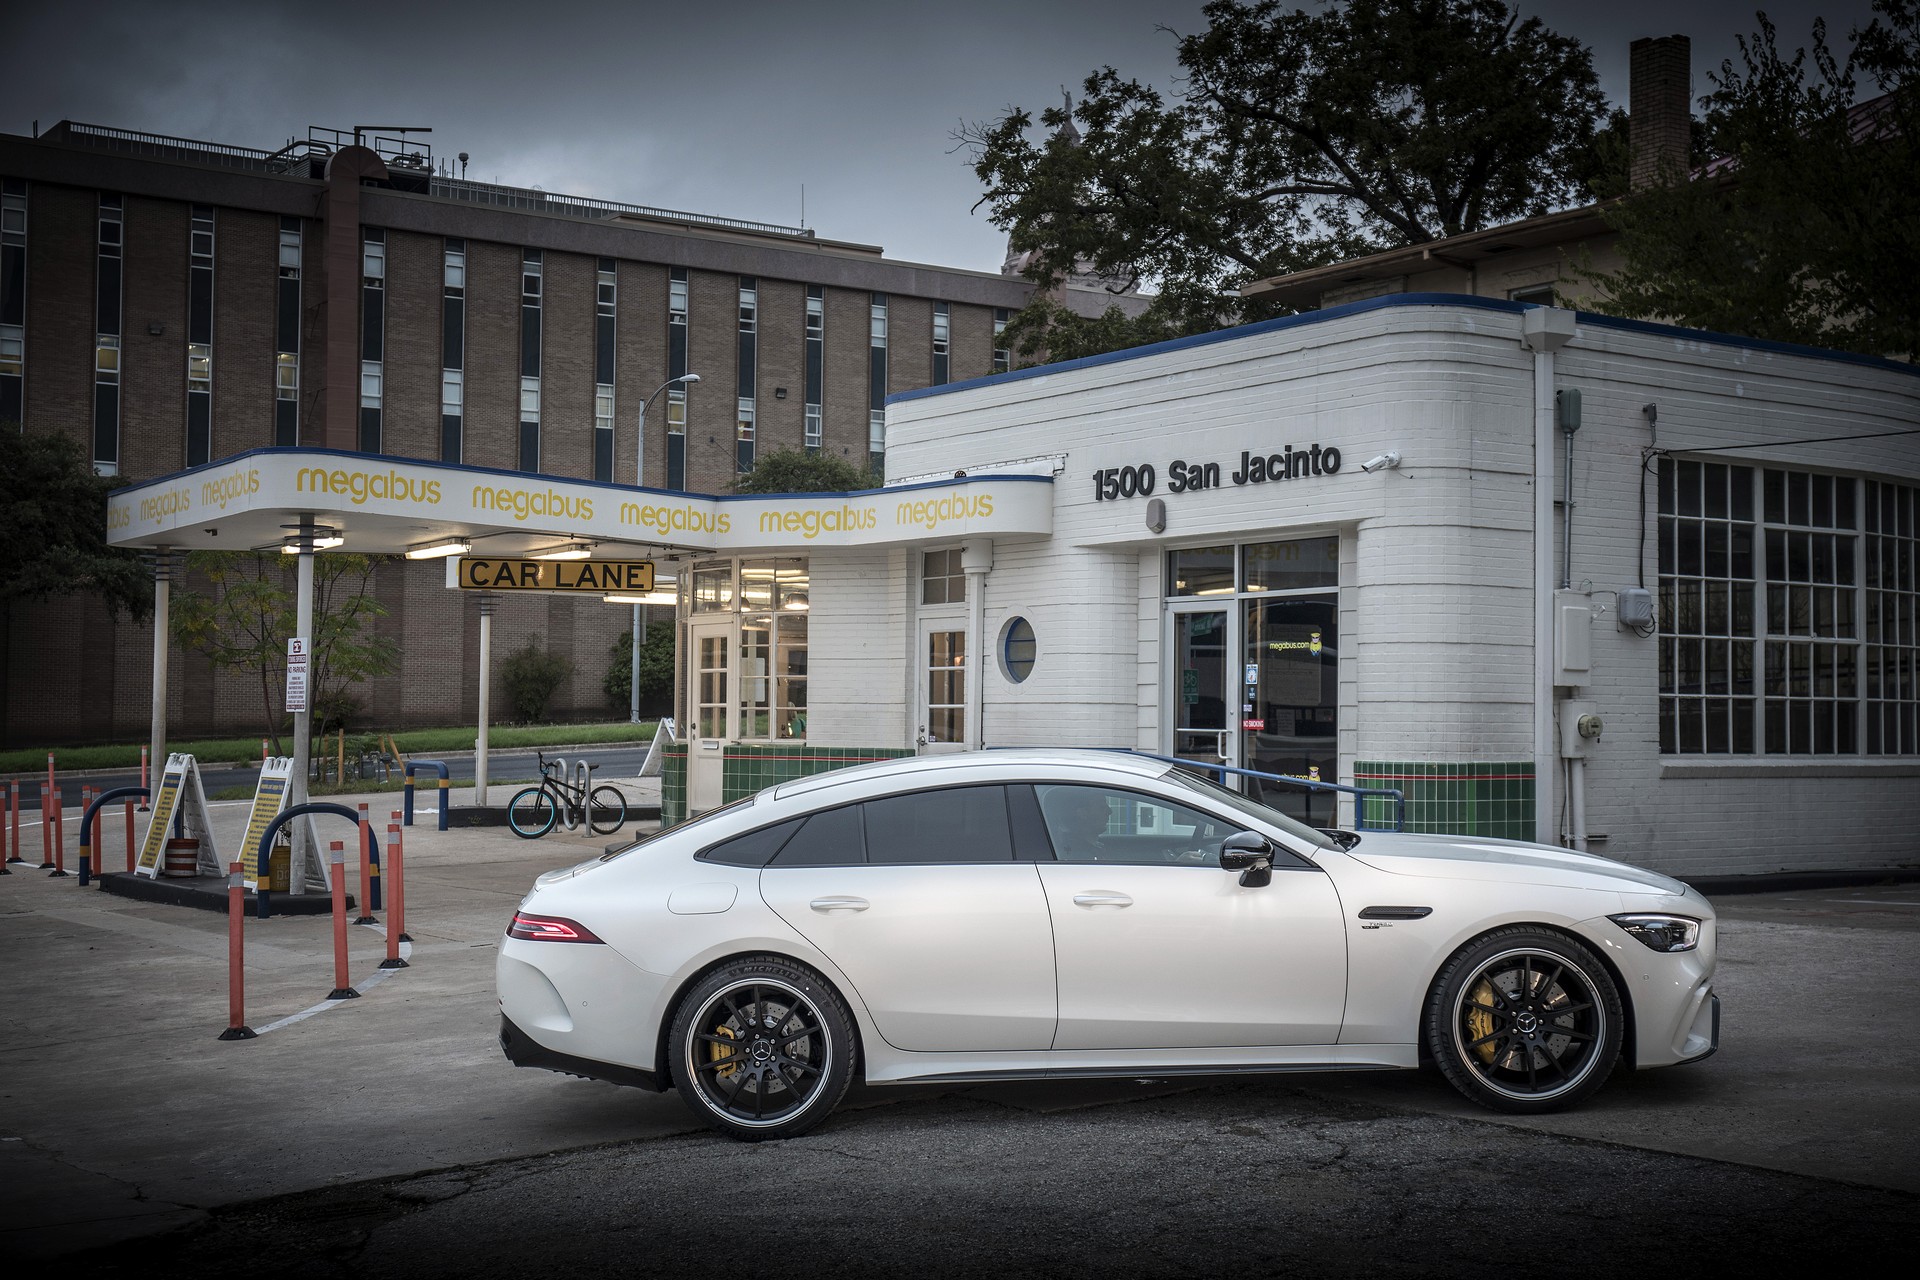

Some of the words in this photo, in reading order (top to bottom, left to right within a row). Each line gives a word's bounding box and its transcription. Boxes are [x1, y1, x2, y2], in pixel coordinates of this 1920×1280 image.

[202, 468, 260, 510] megabus
[296, 467, 442, 505] megabus
[1092, 463, 1155, 501] 1500
[1167, 460, 1220, 493] San
[1232, 443, 1341, 485] Jacinto
[140, 487, 190, 525] megabus
[472, 485, 594, 521] megabus
[620, 502, 731, 536] megabus
[896, 491, 994, 530] megabus
[759, 504, 877, 539] megabus
[469, 561, 540, 587] CAR
[555, 563, 645, 589] LANE
[1269, 641, 1310, 651] megabus.com
[1243, 720, 1249, 728] NO
[1249, 720, 1264, 728] SMOKING
[743, 965, 799, 981] MICHELIN
